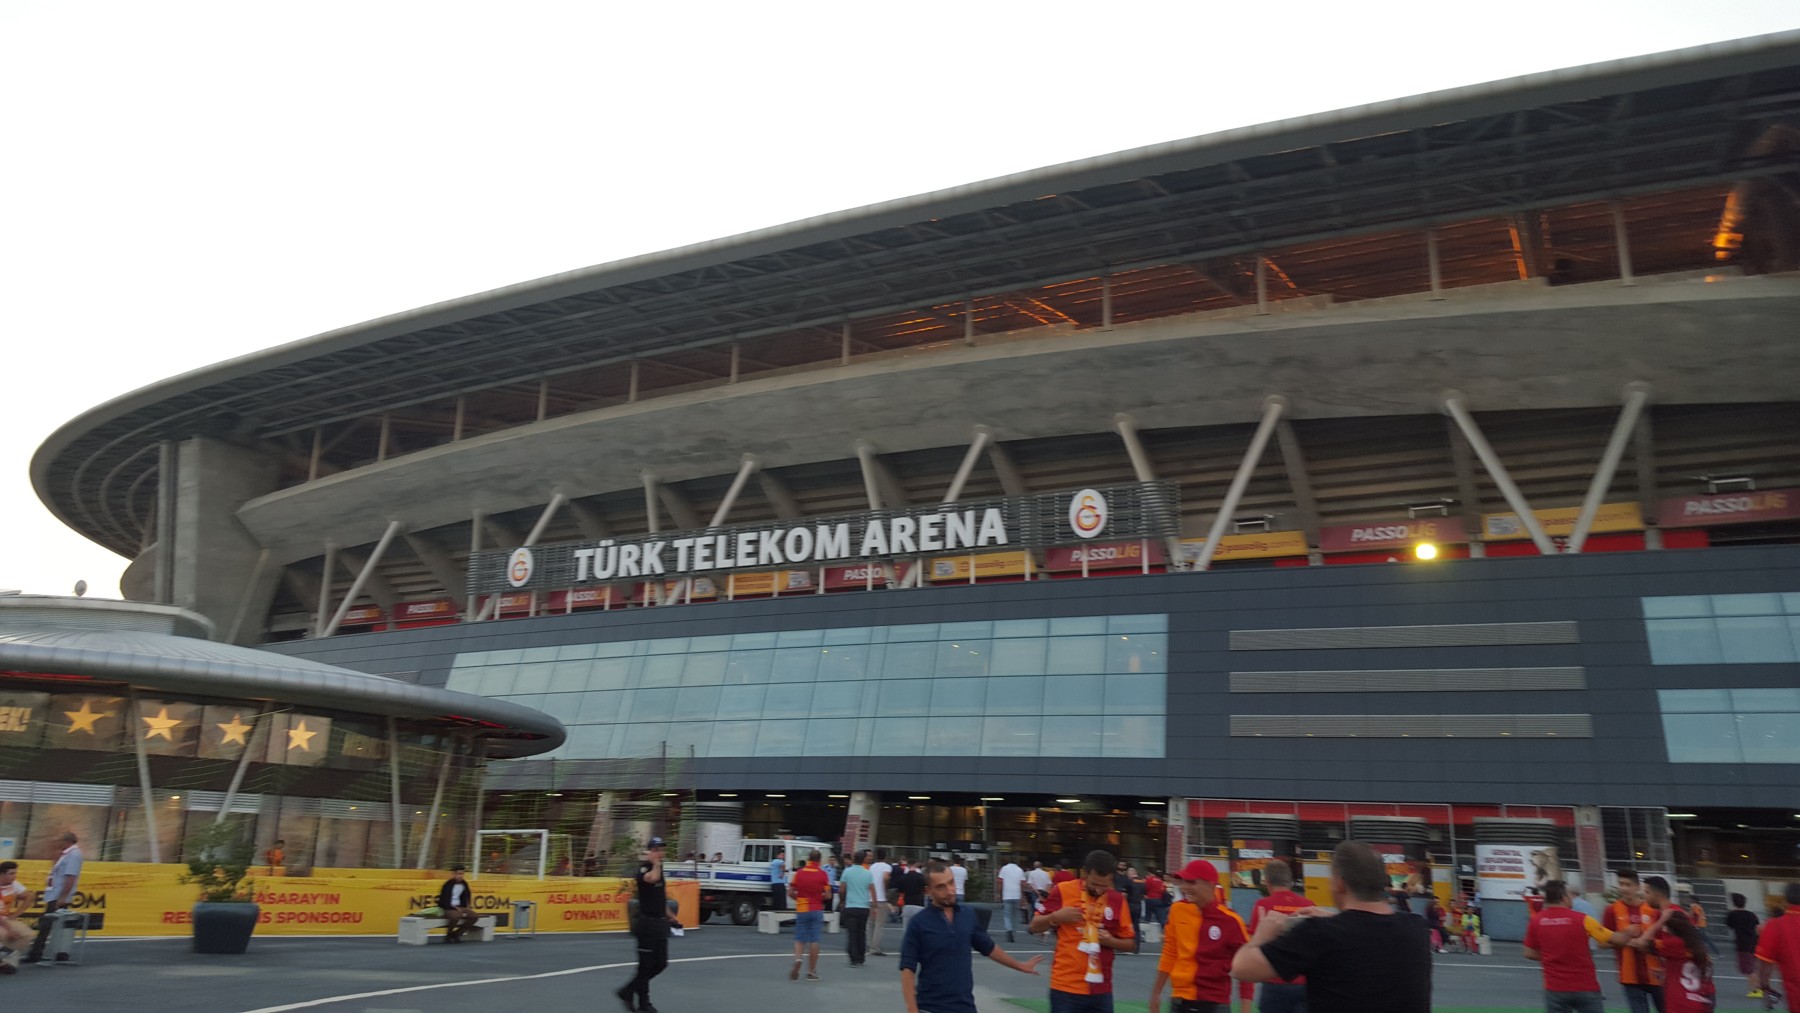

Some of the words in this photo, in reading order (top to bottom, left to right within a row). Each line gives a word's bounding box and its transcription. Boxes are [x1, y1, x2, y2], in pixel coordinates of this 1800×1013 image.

[574, 539, 666, 581] TÜRK
[672, 523, 850, 572] TELEKOM
[859, 508, 1008, 556] ARENA
[547, 893, 613, 905] ASLANLAR
[275, 911, 364, 924] SPONSORU
